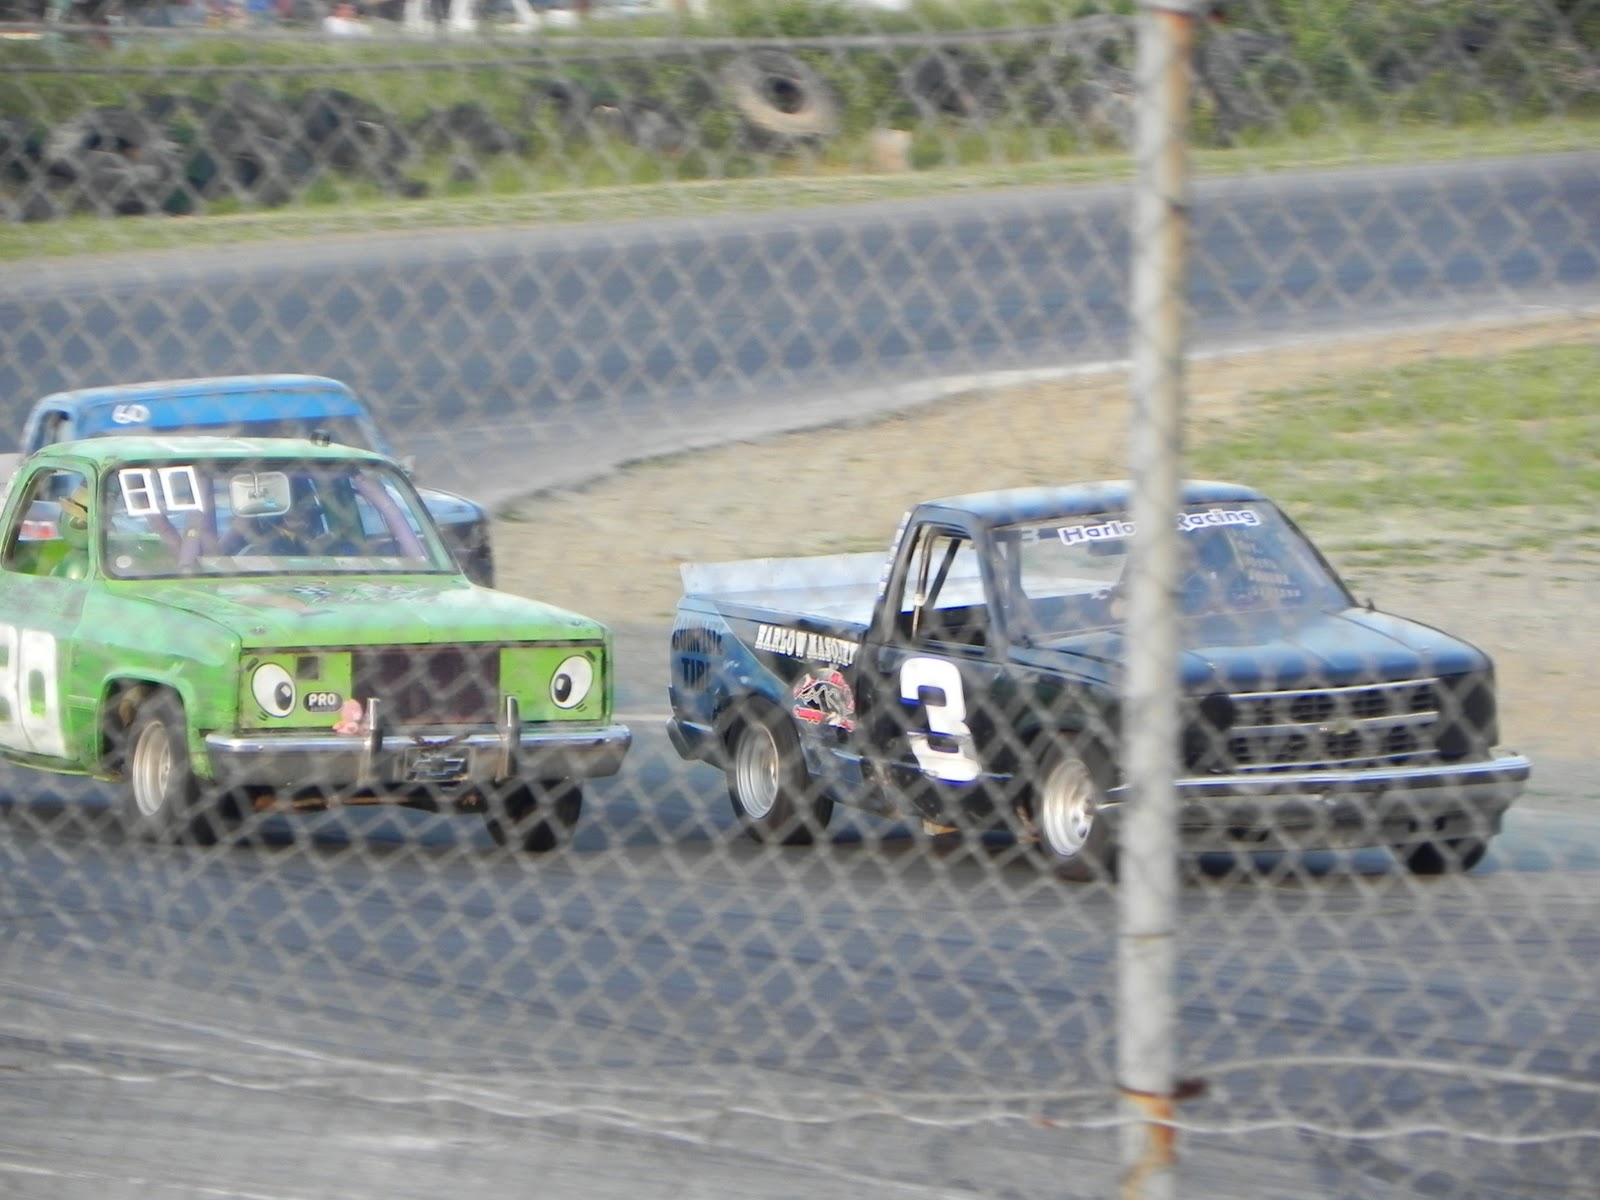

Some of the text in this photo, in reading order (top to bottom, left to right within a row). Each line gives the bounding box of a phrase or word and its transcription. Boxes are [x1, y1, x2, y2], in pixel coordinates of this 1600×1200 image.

[112, 404, 150, 424] 60
[118, 465, 203, 516] 80
[1060, 521, 1136, 545] Harlo
[755, 624, 808, 658] HARLOW
[308, 693, 336, 706] PRO
[899, 657, 982, 785] 3
